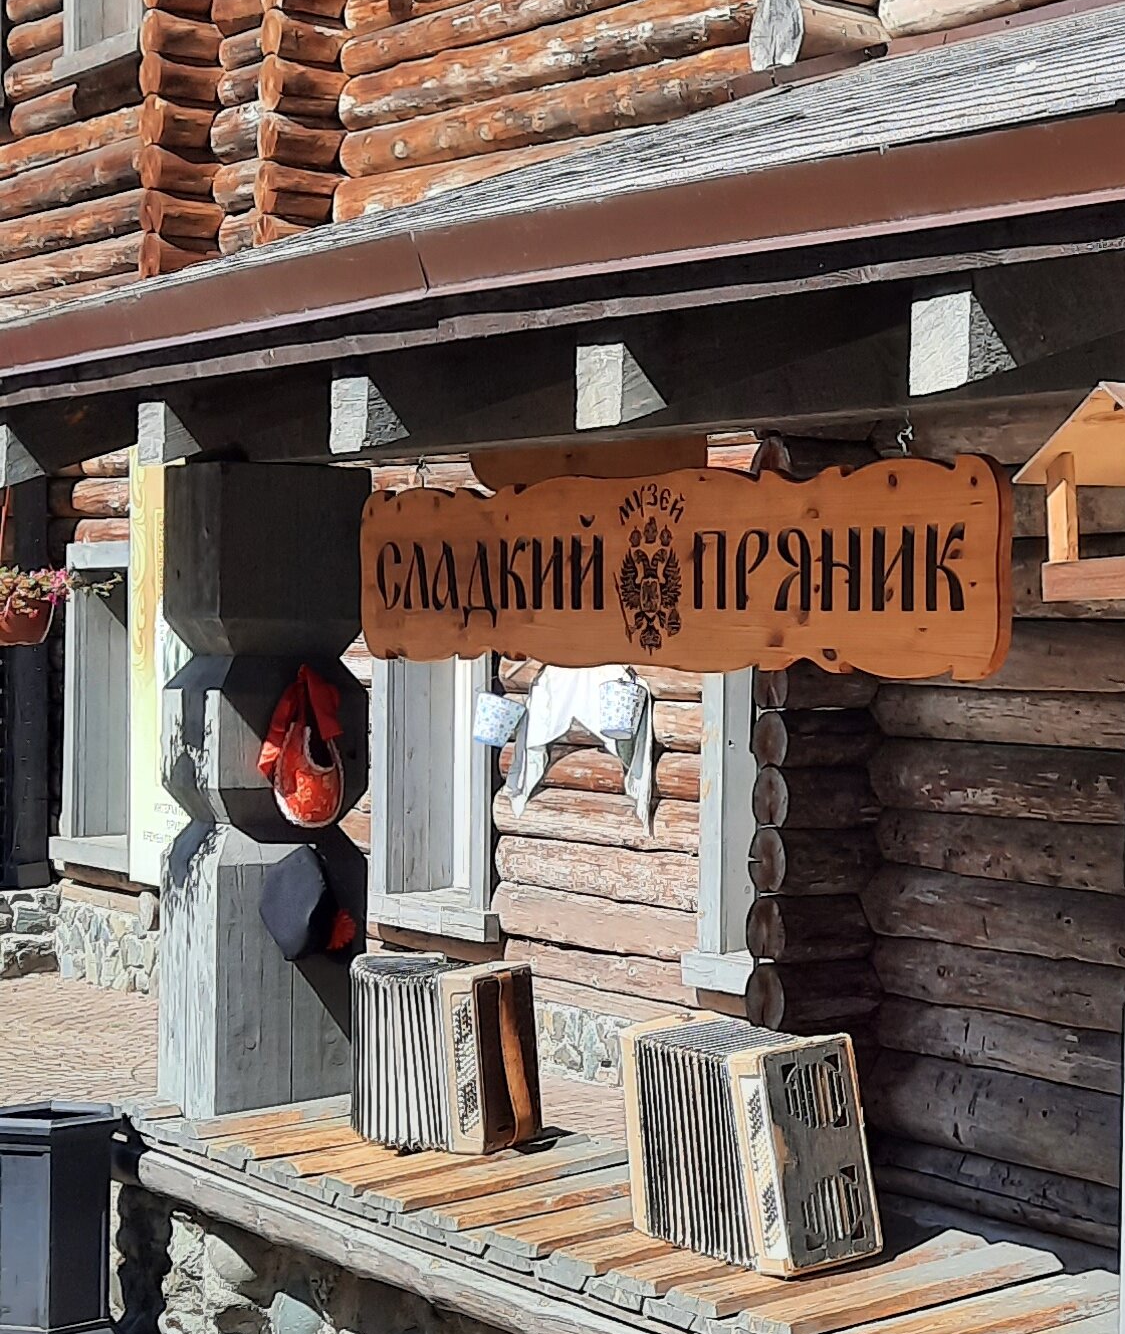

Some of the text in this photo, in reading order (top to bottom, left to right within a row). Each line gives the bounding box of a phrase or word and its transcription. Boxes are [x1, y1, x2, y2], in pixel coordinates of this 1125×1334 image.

[618, 482, 686, 526] МУЗЕЙ
[375, 512, 966, 629] СЛАДКИЙ ПРЯНИК
